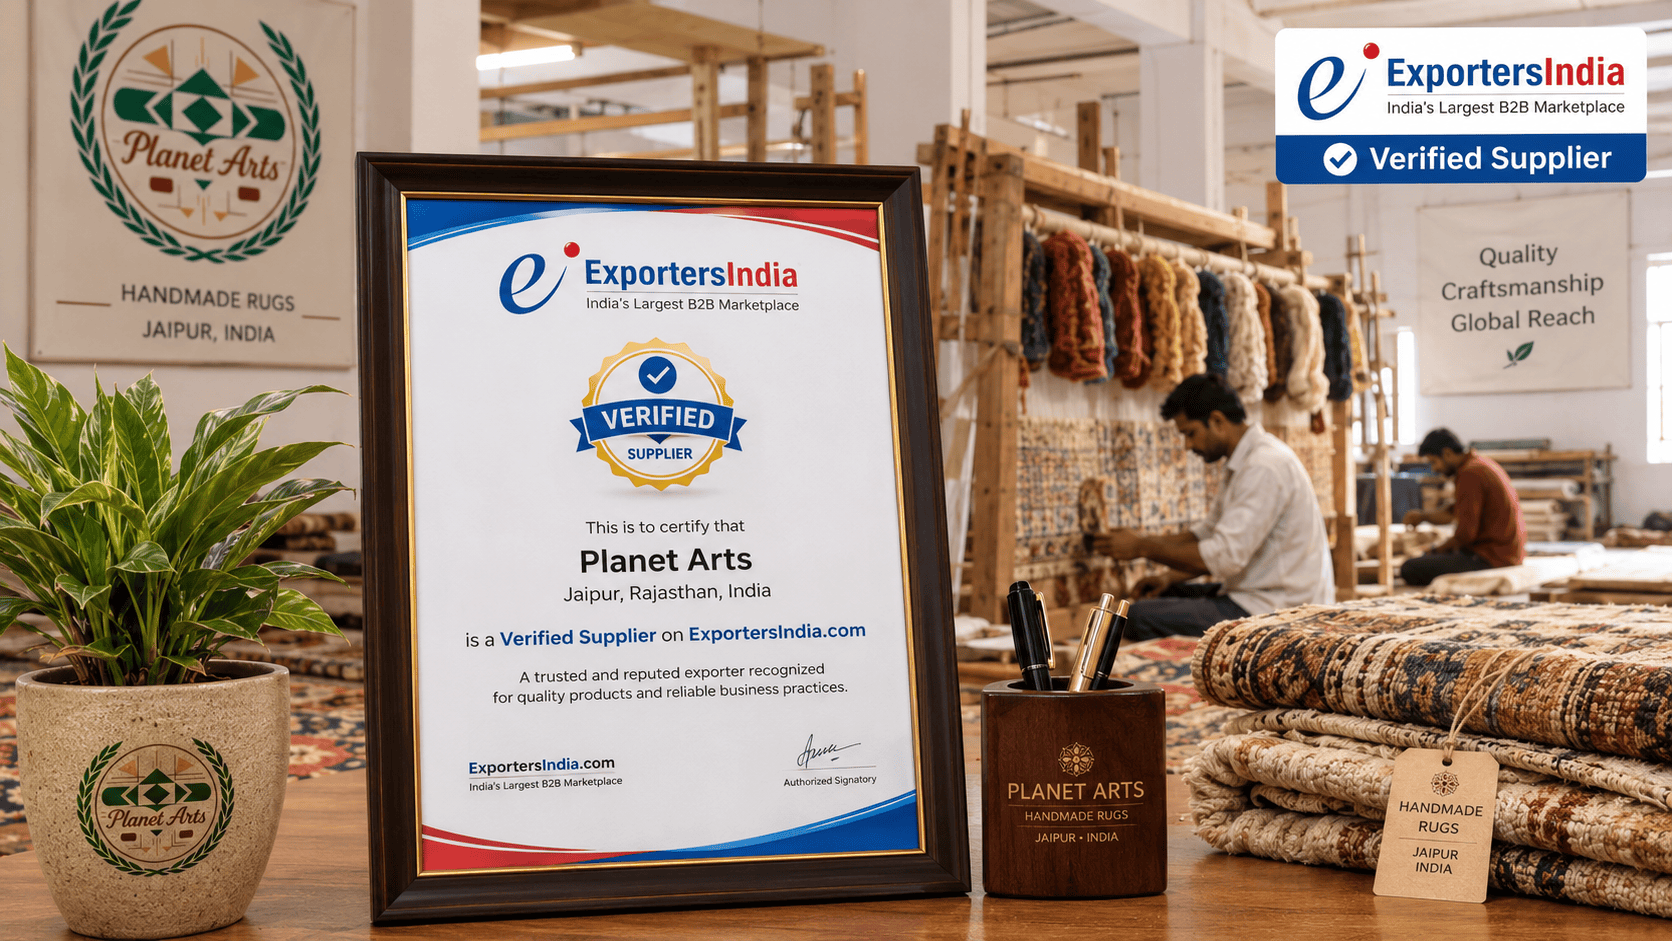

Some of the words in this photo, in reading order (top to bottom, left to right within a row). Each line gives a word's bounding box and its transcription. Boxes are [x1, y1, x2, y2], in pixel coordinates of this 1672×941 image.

[121, 130, 214, 173] Planet
[218, 145, 279, 181] Arts
[1479, 244, 1558, 268] Quality
[586, 259, 798, 290] ExportersIndia
[1442, 273, 1604, 301] Craftsmanship
[122, 284, 240, 308] HANDMADE
[248, 293, 295, 312] RUGS
[586, 297, 629, 310] India's
[634, 298, 684, 312] Largest
[688, 299, 715, 310] B2B
[719, 299, 799, 313] Marketplace
[1451, 309, 1520, 332] Global
[1529, 306, 1595, 328] Reach
[143, 321, 218, 342] JAIPUR,
[225, 325, 275, 342] INDIA
[601, 405, 715, 431] VERIFIED
[627, 447, 692, 460] SUPPLIER
[586, 521, 618, 534] This
[622, 521, 634, 534] is
[639, 522, 655, 534] to
[659, 519, 710, 536] certify
[714, 519, 745, 532] that
[580, 548, 678, 574] Planet
[688, 548, 752, 571] Arts
[563, 585, 624, 606] Jaipur,
[629, 584, 723, 603] Rajasthan,
[728, 583, 771, 599] India
[466, 633, 479, 647] is
[484, 636, 495, 647] a
[500, 629, 574, 647] Verified
[579, 628, 656, 647] Supplier
[661, 631, 683, 642] on
[689, 623, 866, 643] ExportersIndia.com
[519, 672, 530, 684] A
[534, 669, 588, 683] trusted
[592, 668, 619, 682] and
[623, 667, 680, 684] reputed
[684, 666, 744, 682] exporter
[749, 662, 824, 680] recognized
[493, 691, 513, 704] for
[517, 689, 565, 705] quality
[569, 687, 632, 704] products
[636, 685, 662, 699] and
[666, 684, 716, 698] reliable
[720, 682, 779, 697] business
[783, 681, 848, 697] practices.
[469, 757, 615, 776] ExportersIndia.com
[469, 780, 500, 791] India's
[503, 779, 539, 792] Largest
[542, 779, 561, 789] B2B
[564, 776, 623, 790] Marketplace
[784, 777, 832, 787] Authorized
[835, 775, 876, 788] Signatory
[1008, 783, 1086, 800] PLANET
[1093, 781, 1144, 799] ARTS
[106, 809, 164, 828] Planet
[166, 806, 206, 826] Arts
[1025, 811, 1094, 821] HANDMADE
[1098, 810, 1128, 820] RUGS
[1399, 801, 1483, 816] HANDMADE
[1035, 833, 1076, 843] JAIPUR
[1087, 832, 1119, 842] INDIA
[1419, 821, 1459, 834] RUGS
[1413, 847, 1458, 860] JAIPUR
[1416, 863, 1452, 874] INDIA
